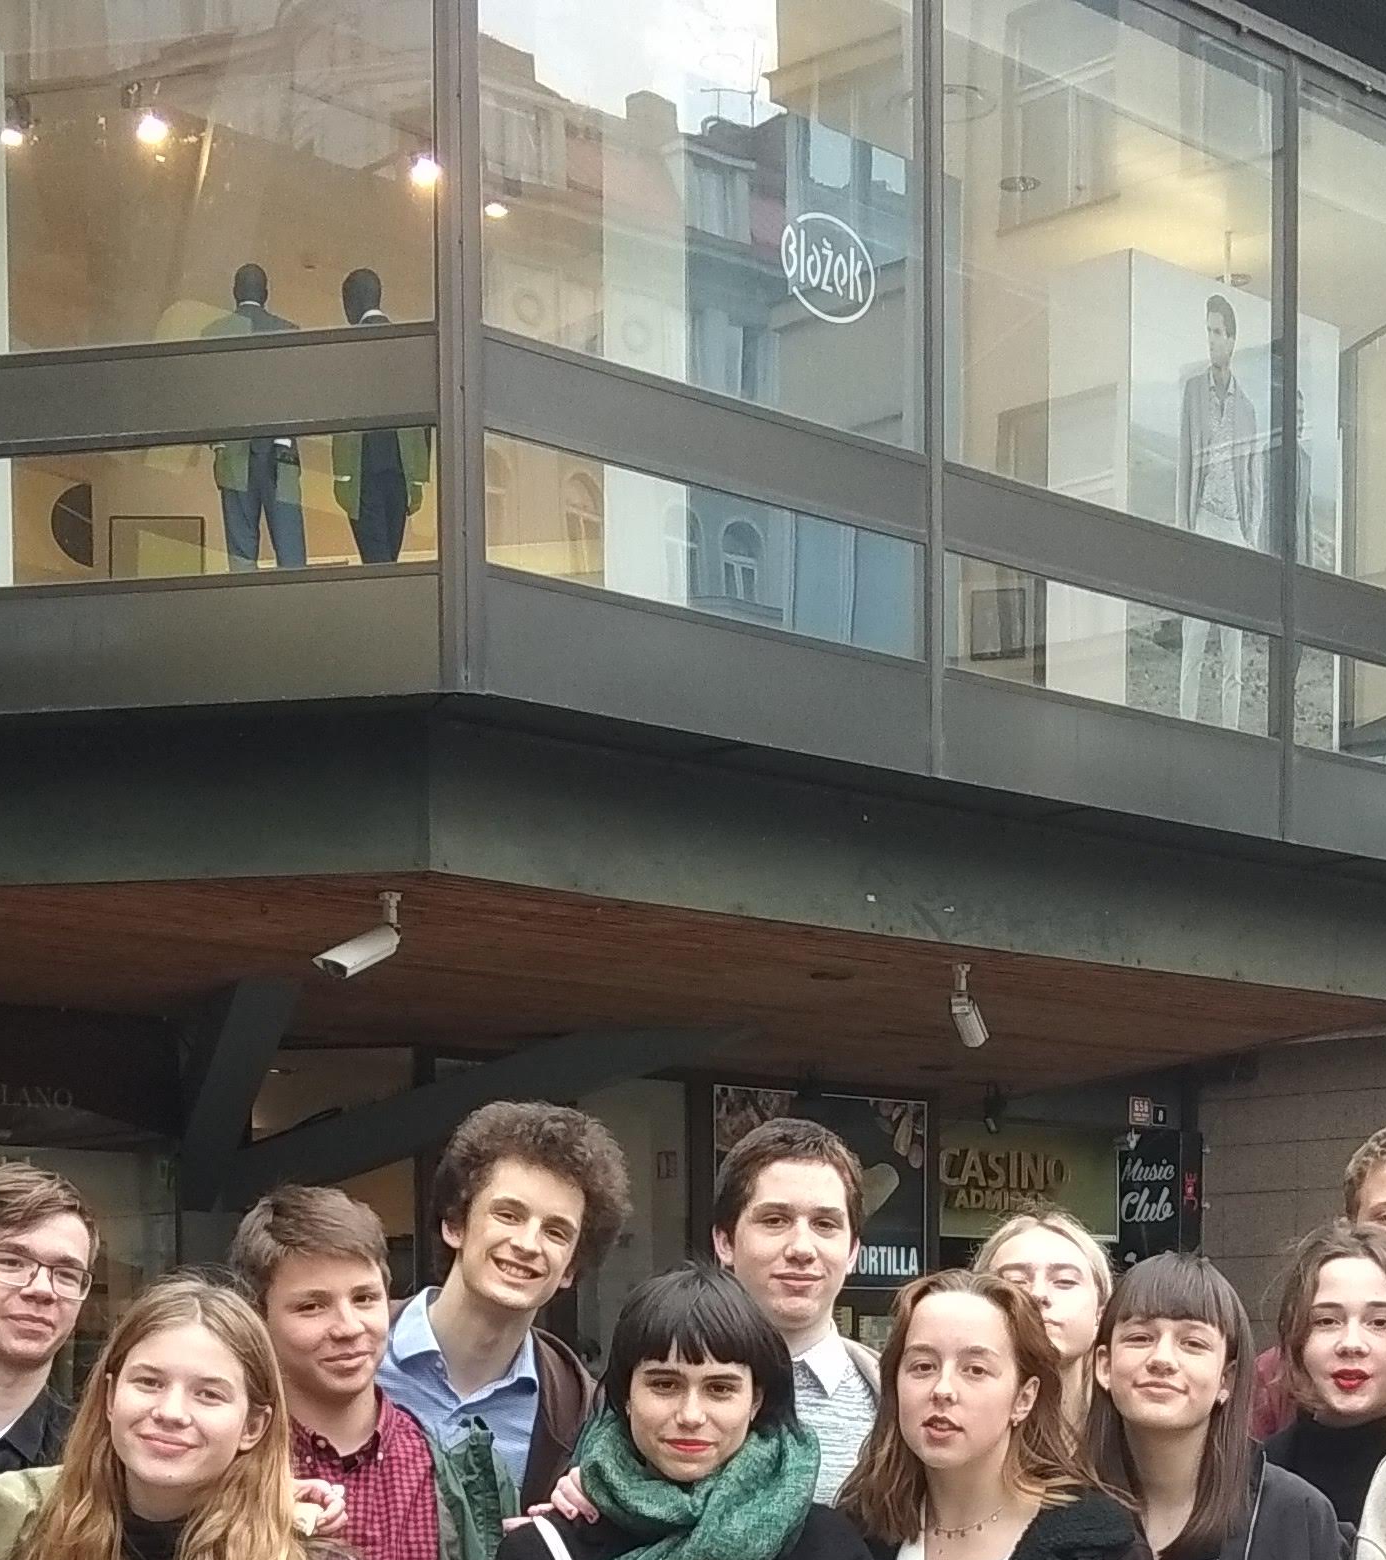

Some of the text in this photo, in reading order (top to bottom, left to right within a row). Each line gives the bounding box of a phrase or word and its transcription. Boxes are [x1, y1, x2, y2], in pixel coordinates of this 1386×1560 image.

[939, 1148, 1069, 1190] CASINO
[1121, 1157, 1175, 1182] Music
[1120, 1186, 1175, 1223] Club
[852, 1244, 919, 1276] ORTILLA
